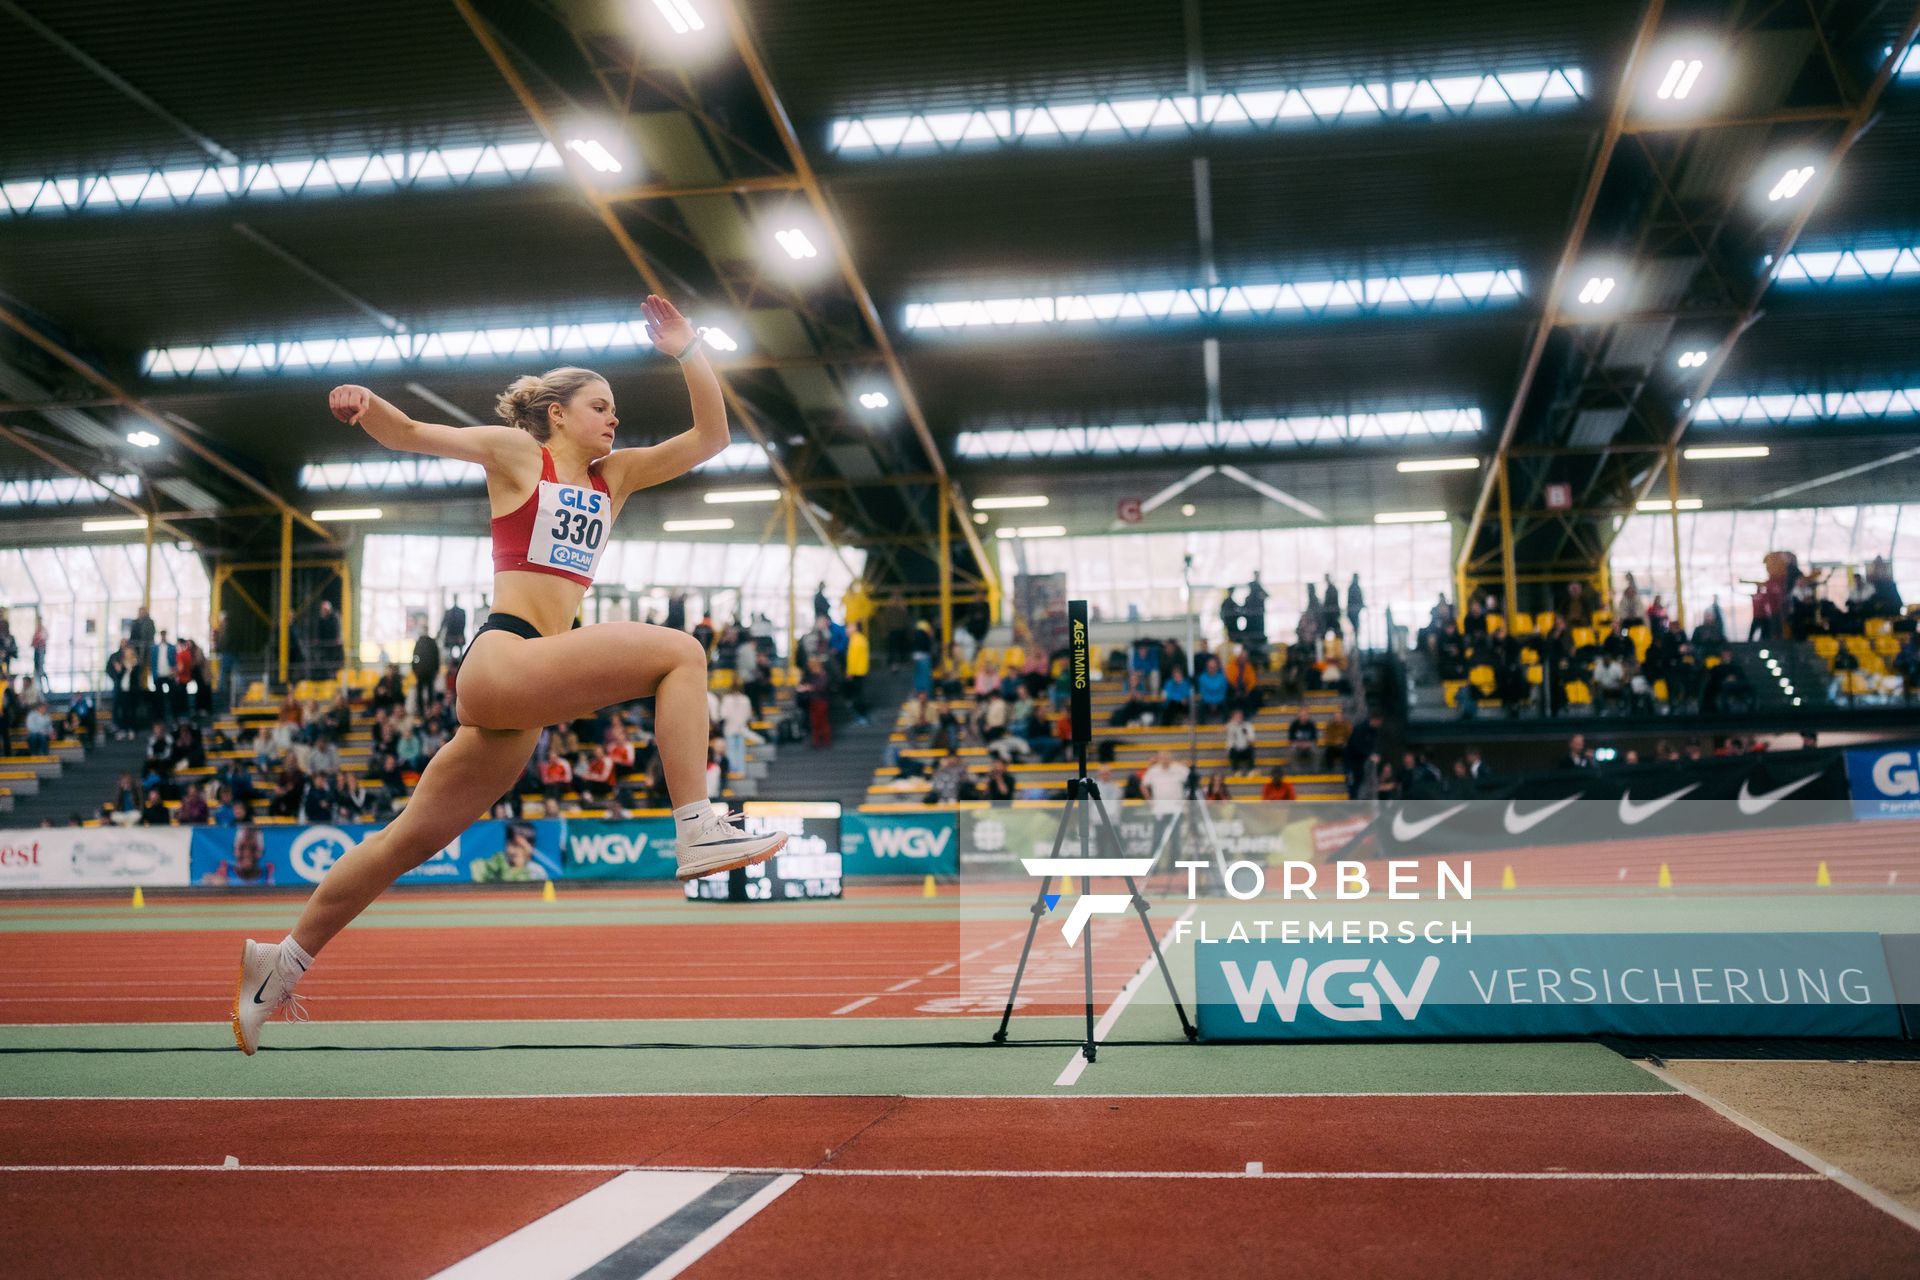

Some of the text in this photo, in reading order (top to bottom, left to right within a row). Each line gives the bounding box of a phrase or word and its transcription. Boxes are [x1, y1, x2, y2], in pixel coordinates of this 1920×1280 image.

[558, 487, 602, 514] GLS
[551, 508, 603, 550] 330
[571, 551, 592, 566] PLAN
[570, 832, 648, 865] WGV
[868, 826, 952, 858] WGV
[1220, 955, 1872, 1023] WGV VERSICHERUNG
